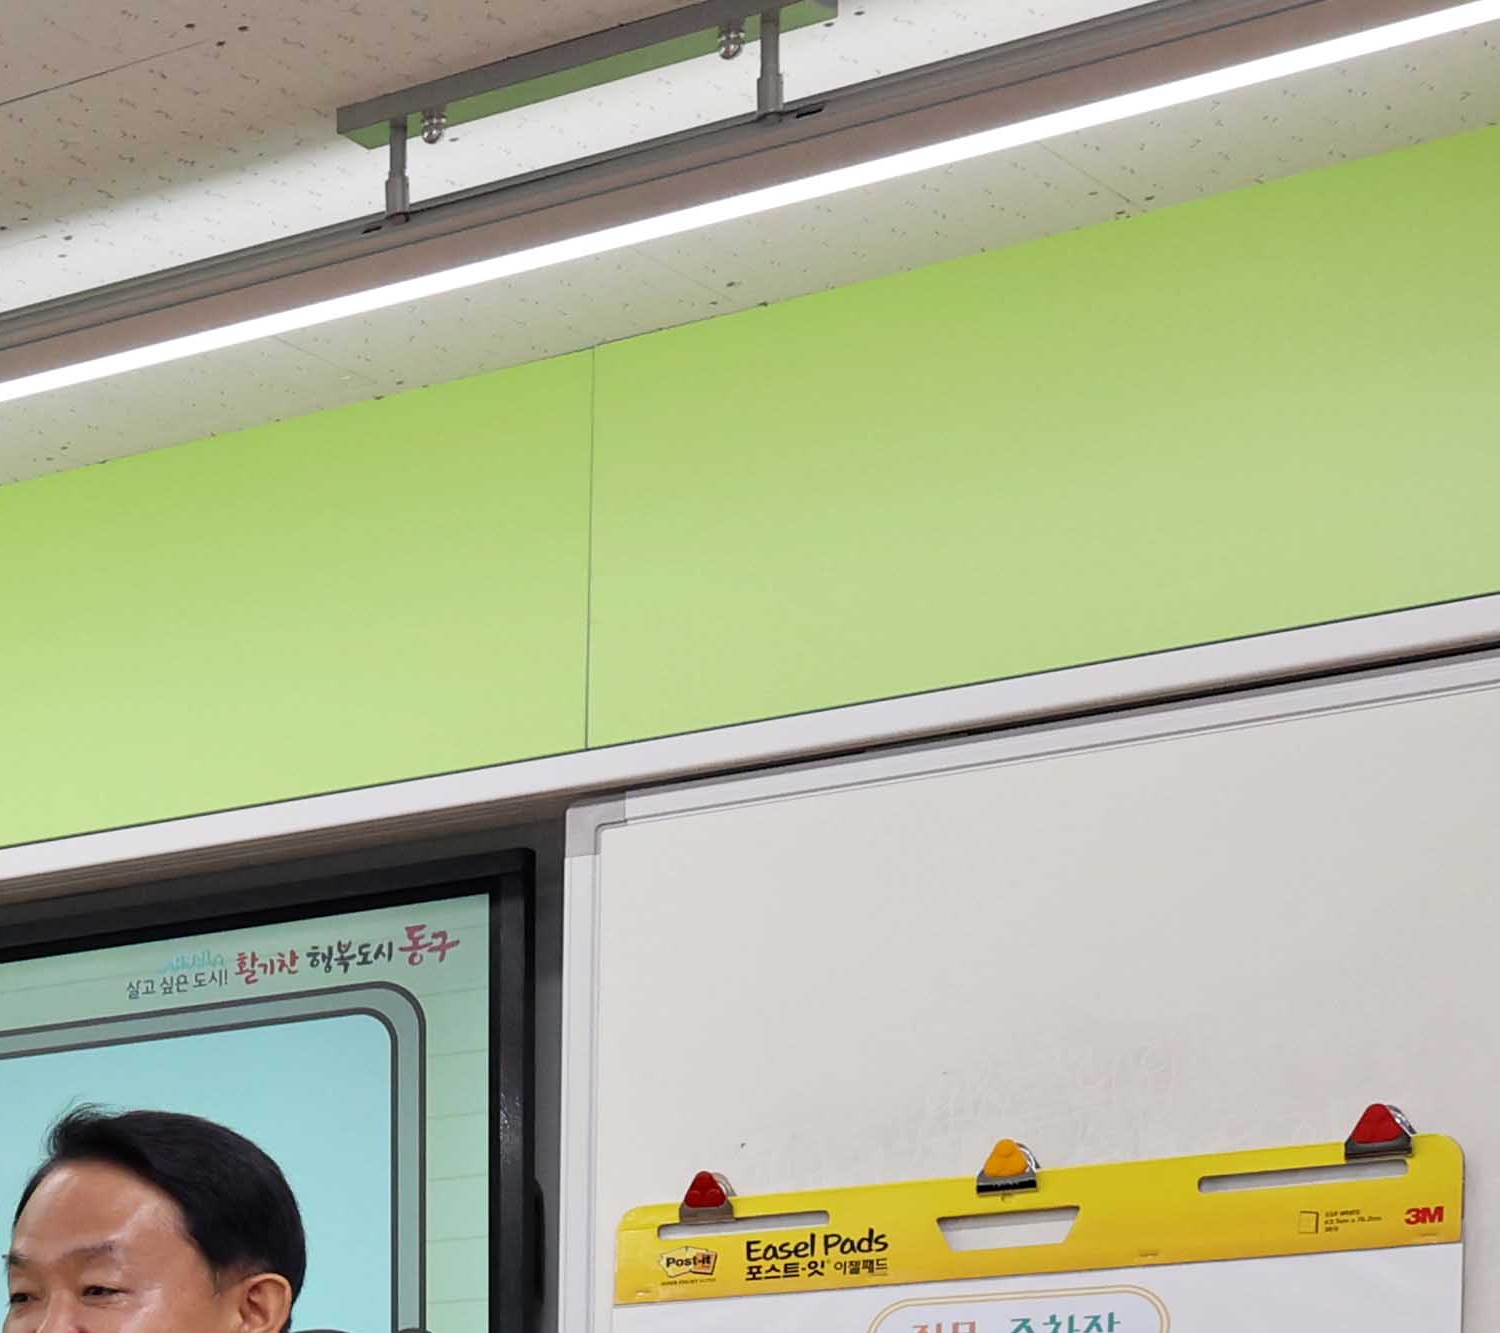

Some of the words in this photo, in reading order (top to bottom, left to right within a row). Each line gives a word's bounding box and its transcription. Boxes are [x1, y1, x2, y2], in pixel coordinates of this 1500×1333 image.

[126, 978, 156, 1000] 살고
[159, 975, 188, 996] 싶은
[194, 968, 229, 988] 도시!
[234, 949, 300, 985] 활기찬
[306, 940, 394, 975] 행복도시
[398, 924, 461, 966] 동구
[1404, 1206, 1444, 1225] 3M
[745, 1233, 816, 1262] Easel
[823, 1229, 889, 1254] Pads
[665, 1254, 712, 1268] Post-it
[835, 1257, 889, 1276] 이젤패드
